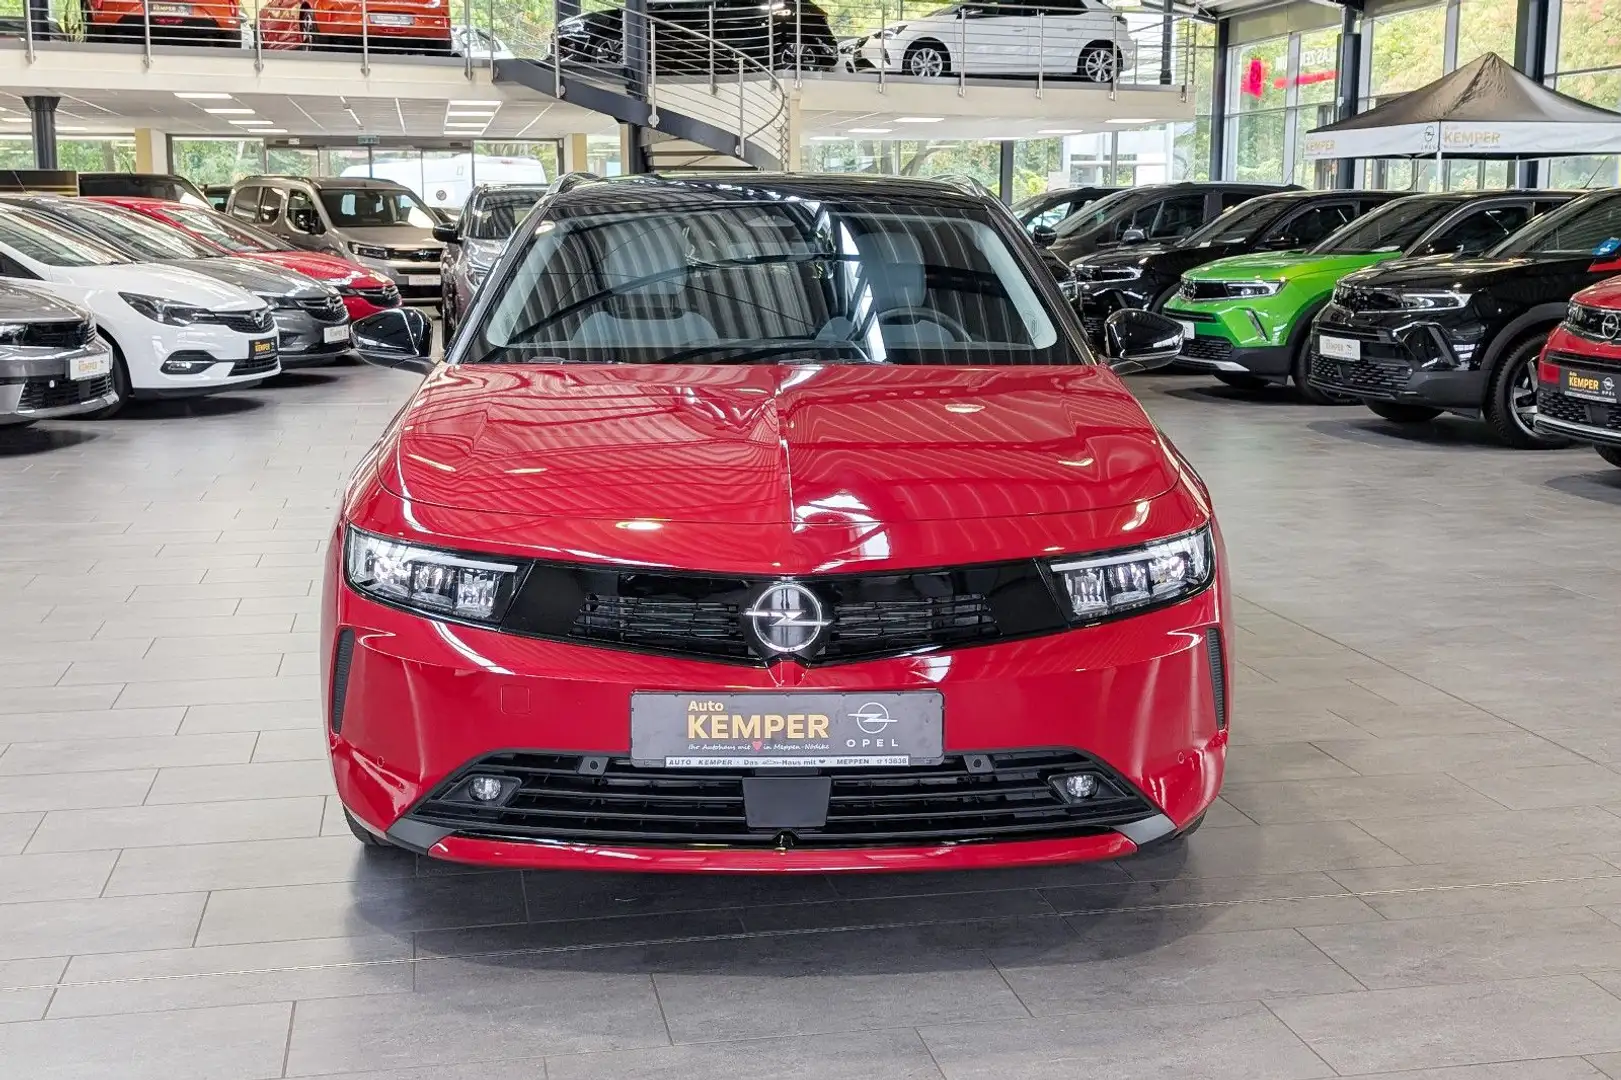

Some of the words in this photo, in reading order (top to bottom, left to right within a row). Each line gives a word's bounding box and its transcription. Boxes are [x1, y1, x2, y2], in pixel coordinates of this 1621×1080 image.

[1443, 131, 1501, 143] KEMPER
[1569, 376, 1599, 390] KEMPER
[687, 700, 724, 712] Auto
[687, 714, 829, 739] KEMPER
[846, 738, 899, 748] OPEL
[743, 758, 759, 766] Das
[803, 758, 816, 766] mit
